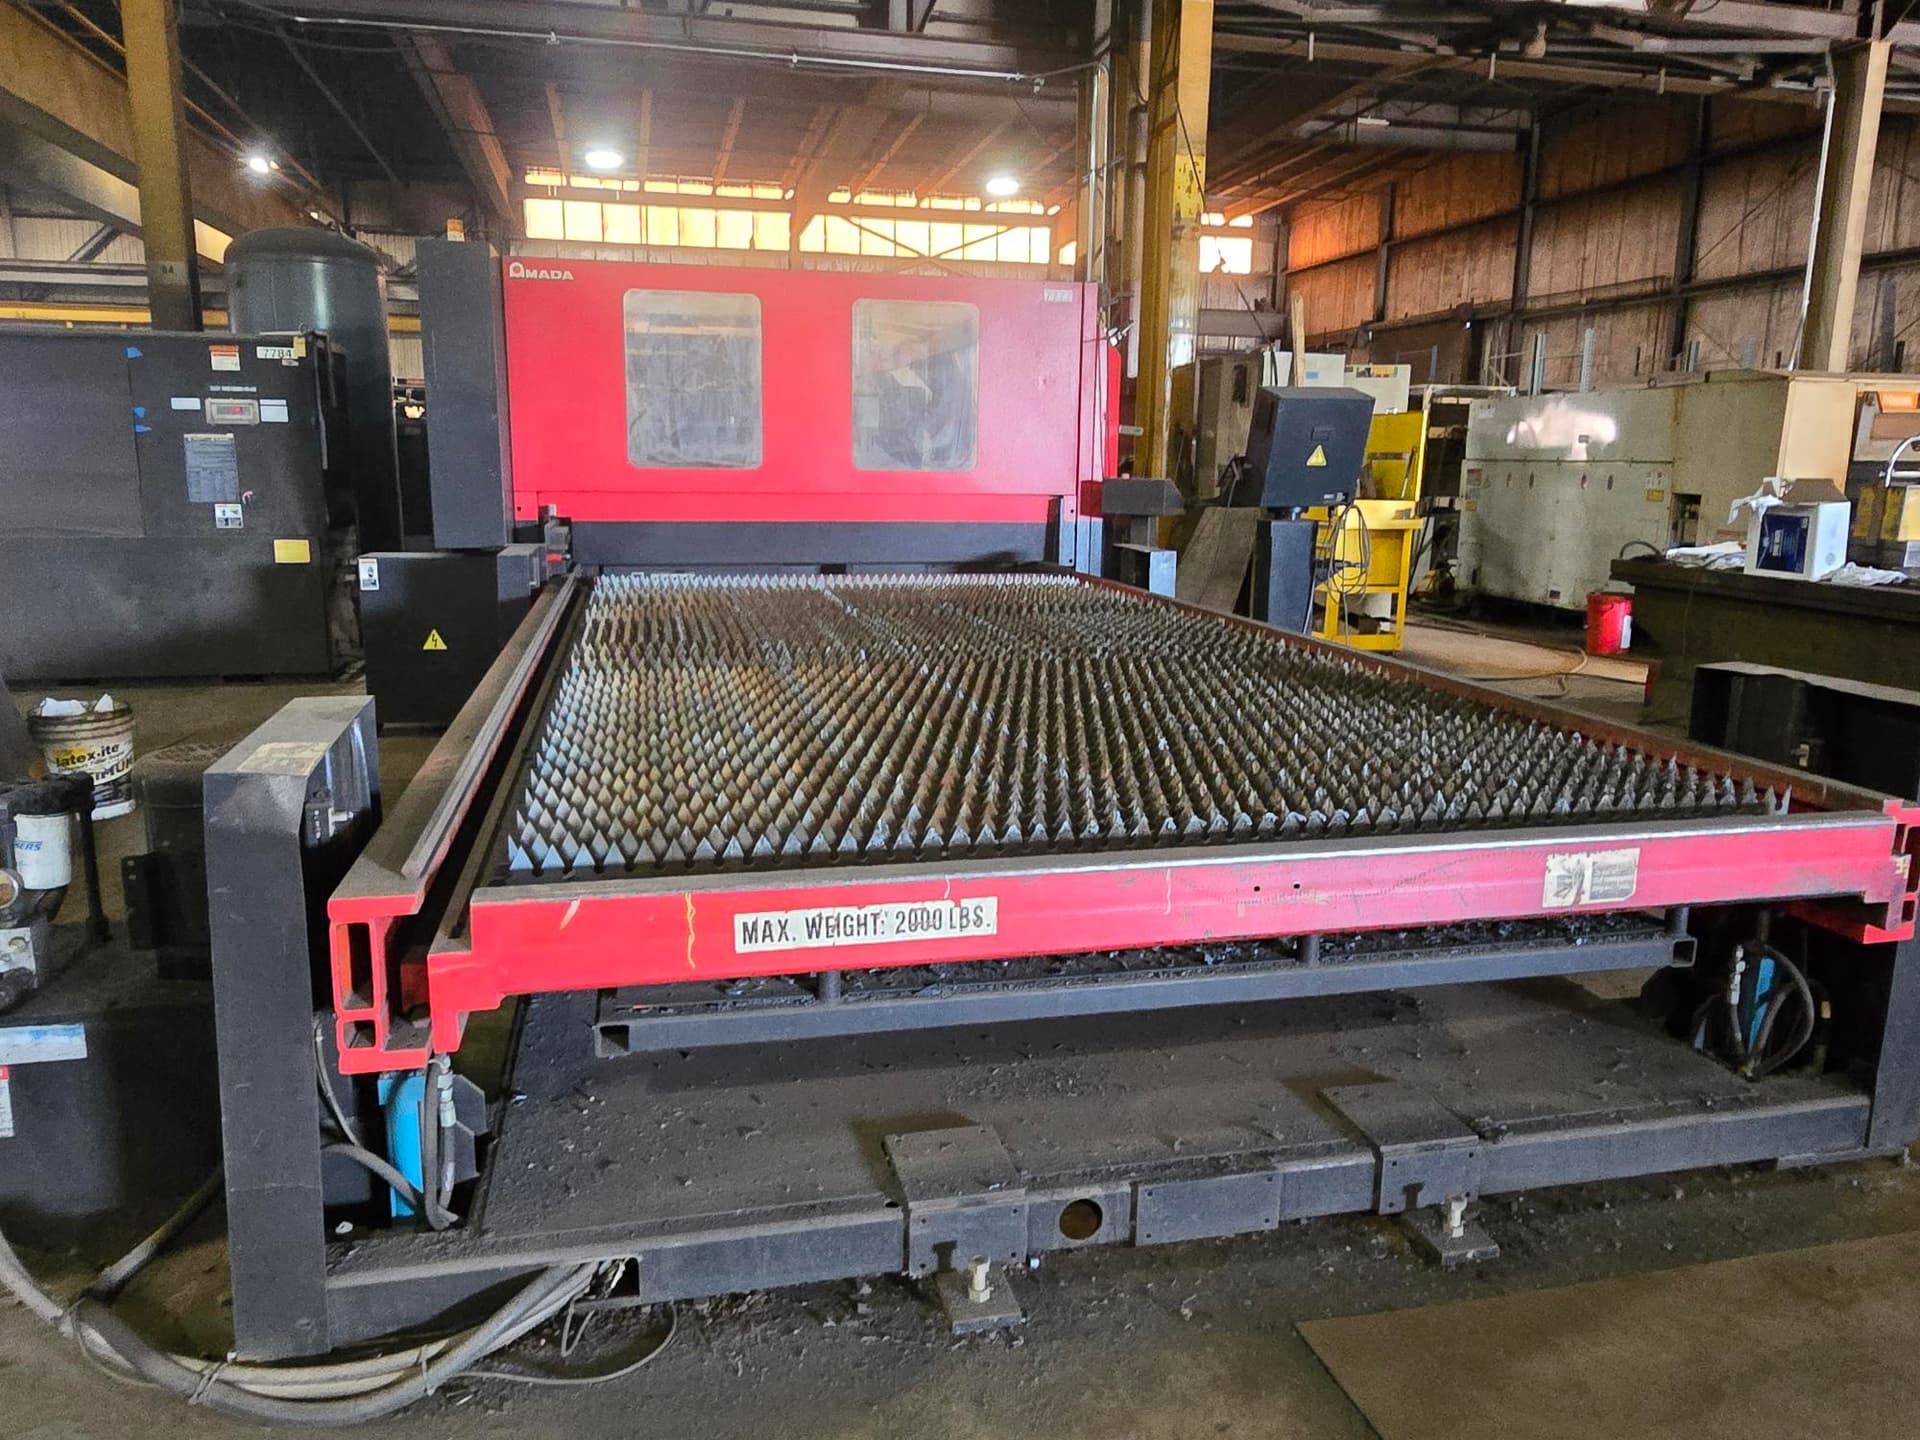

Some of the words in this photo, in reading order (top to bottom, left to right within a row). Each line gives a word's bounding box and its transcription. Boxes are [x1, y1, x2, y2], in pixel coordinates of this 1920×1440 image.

[509, 262, 574, 280] AMADA
[741, 916, 797, 945] MAX.
[805, 911, 886, 940] WEIGHT:
[894, 907, 943, 935] 2000
[949, 905, 992, 930] LBS.
